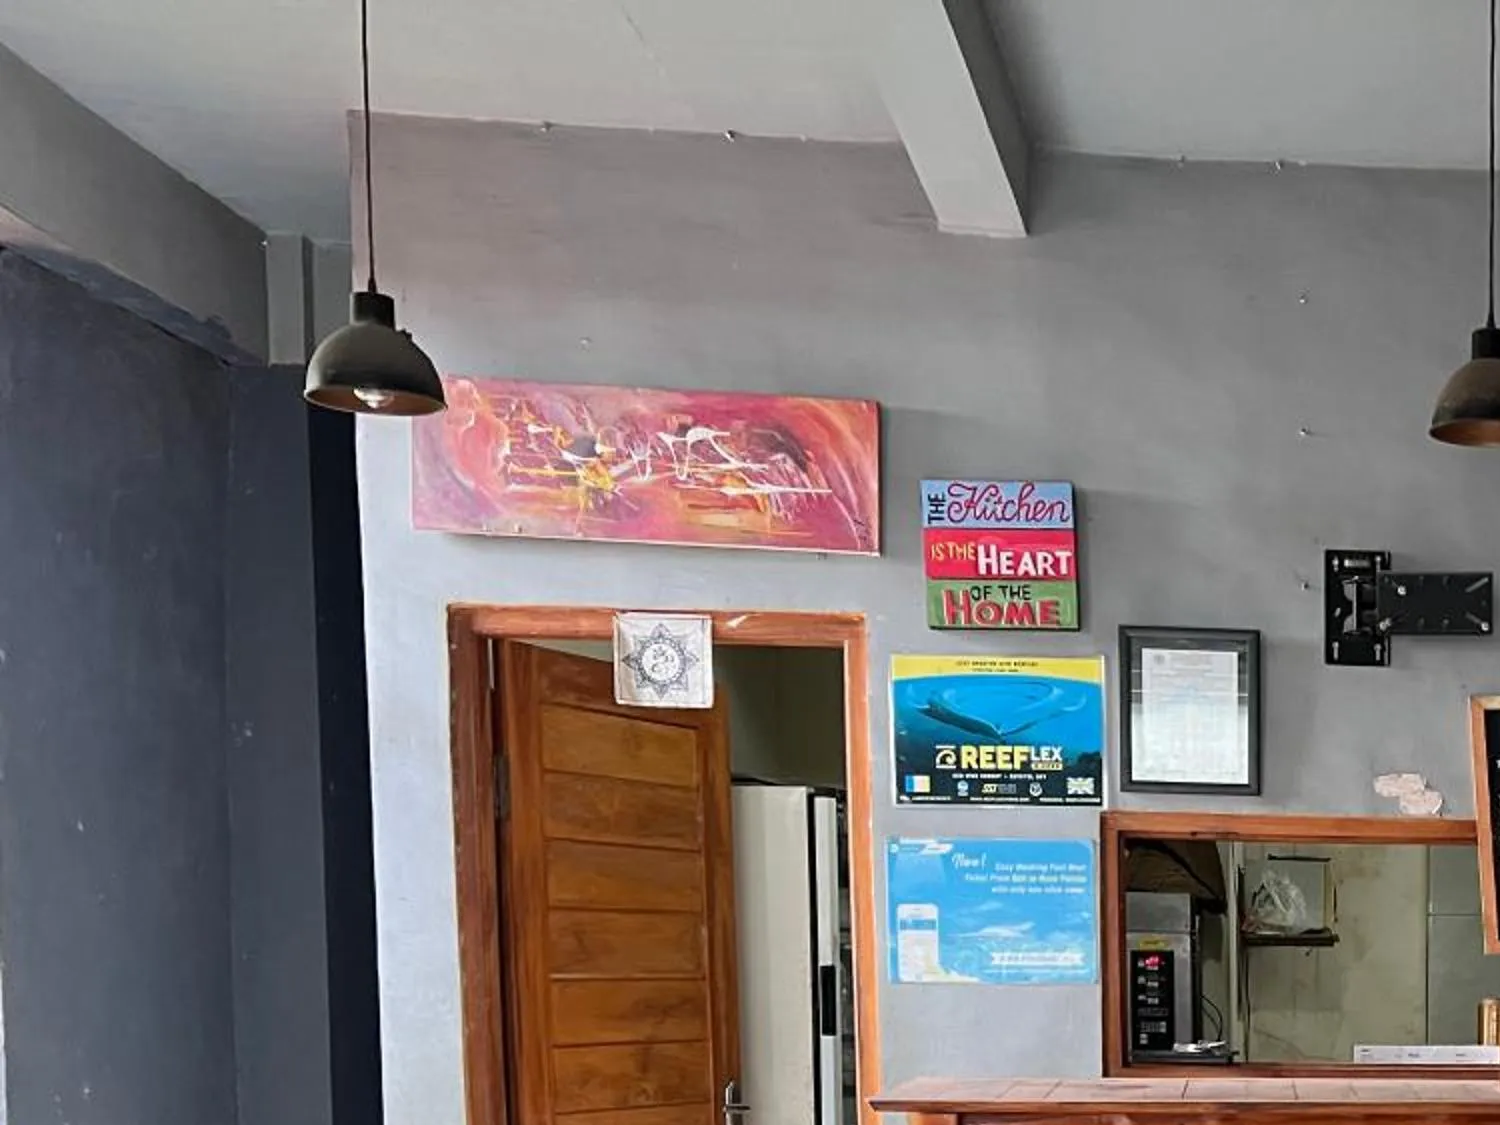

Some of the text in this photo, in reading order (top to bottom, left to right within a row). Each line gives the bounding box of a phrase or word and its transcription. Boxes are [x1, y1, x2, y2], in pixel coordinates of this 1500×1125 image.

[928, 483, 1070, 524] THE Kitchen
[931, 541, 1073, 577] IS THE HEART
[942, 589, 1061, 627] HOME
[971, 585, 1031, 601] OF THE
